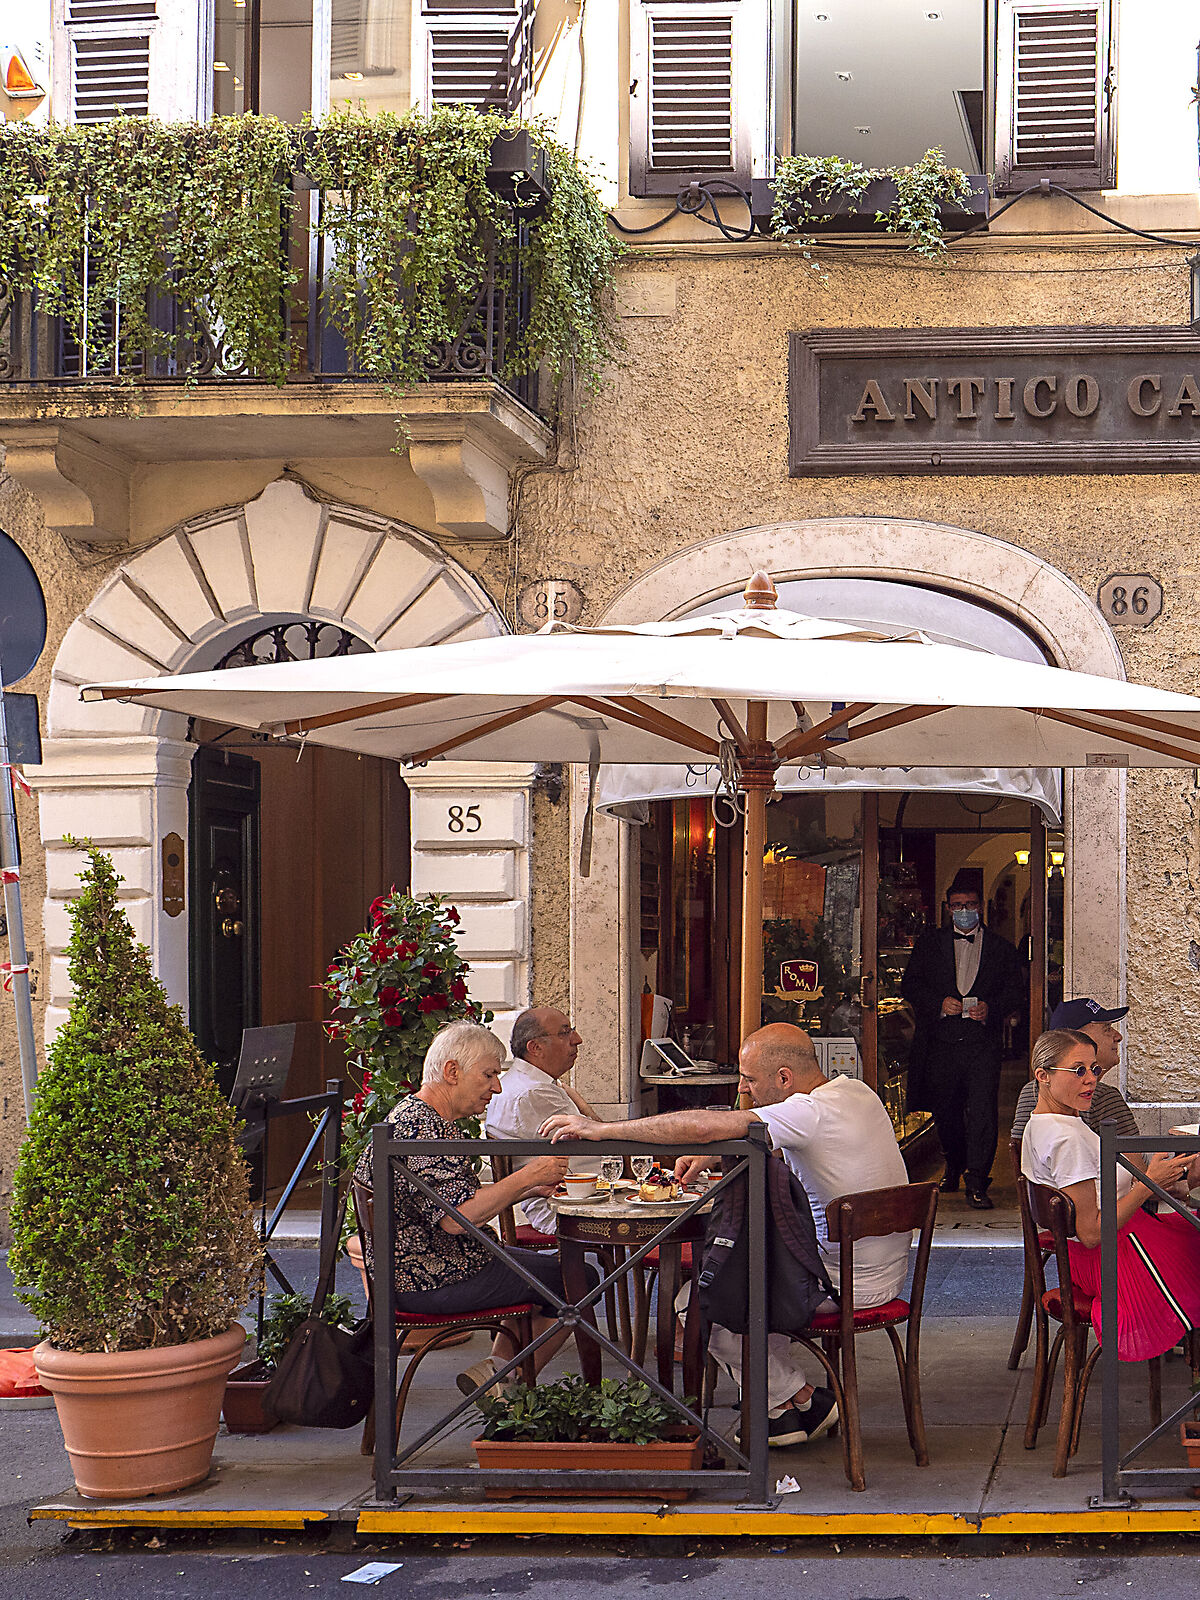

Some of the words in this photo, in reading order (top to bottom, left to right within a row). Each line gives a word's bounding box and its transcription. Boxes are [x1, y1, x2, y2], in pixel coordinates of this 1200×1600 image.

[851, 374, 1100, 422] ANTICO
[534, 591, 568, 618] 85
[1111, 586, 1149, 616] 86
[447, 804, 482, 833] 85
[784, 965, 811, 991] ROMA
